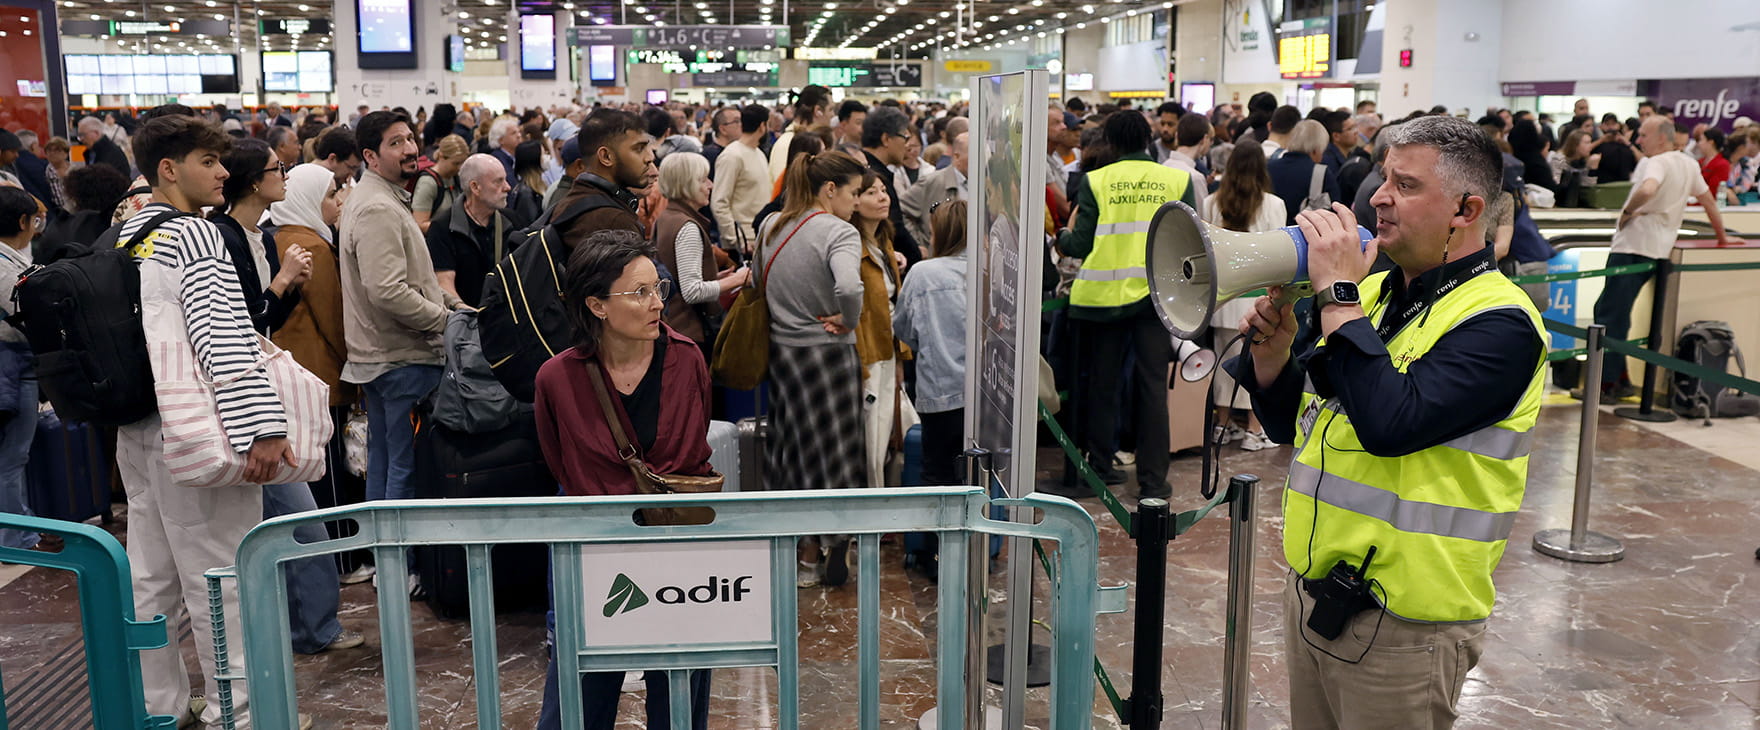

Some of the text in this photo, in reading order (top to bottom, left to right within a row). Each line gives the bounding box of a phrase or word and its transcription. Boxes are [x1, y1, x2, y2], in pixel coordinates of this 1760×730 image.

[1674, 88, 1741, 129] renfe
[1110, 181, 1166, 191] SERVICIOS
[1109, 194, 1167, 205] AUXILARES
[1471, 260, 1490, 275] renfe
[1436, 278, 1458, 296] renfe
[1402, 300, 1424, 319] renfe
[1378, 325, 1391, 337] nfe
[655, 576, 752, 604] adif
